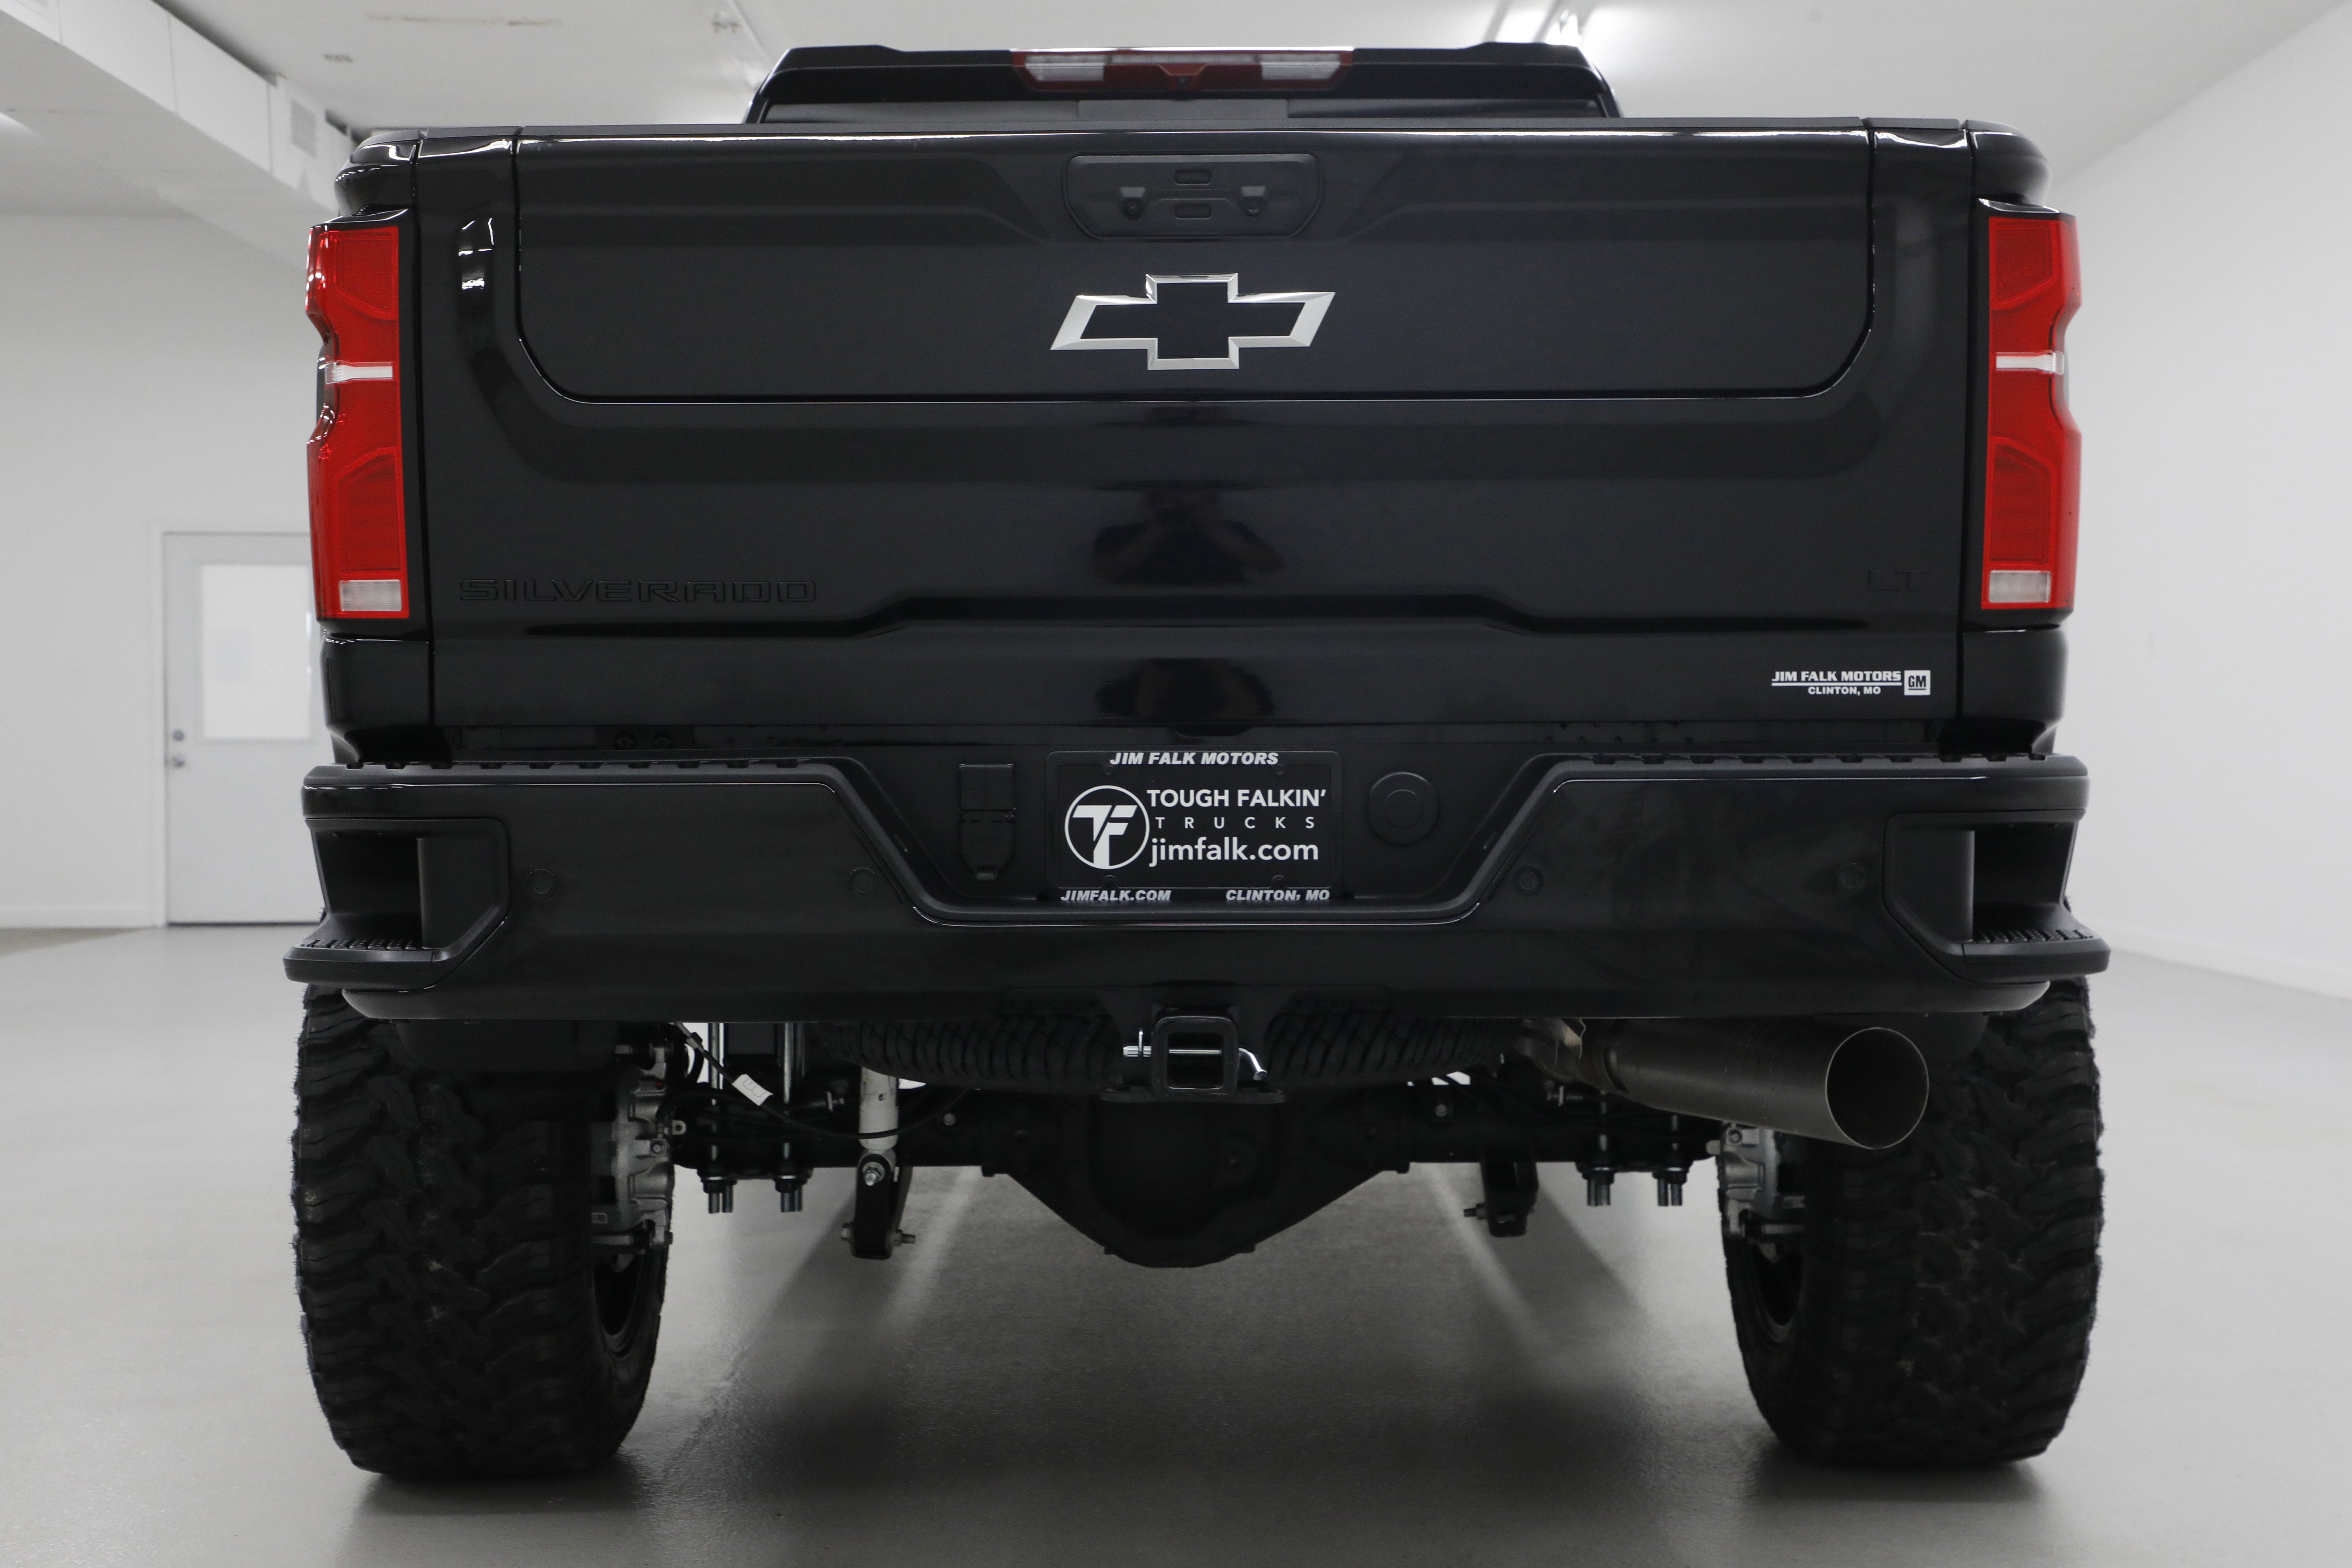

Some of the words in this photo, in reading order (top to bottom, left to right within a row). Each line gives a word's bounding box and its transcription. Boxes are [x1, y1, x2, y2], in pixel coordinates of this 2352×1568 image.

[1867, 568, 1931, 591] LT
[460, 578, 816, 603] SILVERADO
[1771, 670, 1797, 682] JIM
[1801, 670, 1838, 682] FALK
[1841, 670, 1902, 682] MOTORS
[1908, 675, 1927, 687] GM
[1808, 686, 1861, 696] CLINTON,
[1863, 686, 1881, 694] MO
[1109, 752, 1144, 765] JIM
[1148, 752, 1196, 765] FALK
[1200, 752, 1279, 765] MOTORS
[1146, 789, 1229, 807] TOUGH
[1237, 788, 1326, 807] FALKIN'
[1155, 816, 1315, 829] TRUCKS
[1149, 836, 1319, 867] jimfalk.com
[1061, 890, 1172, 901] JIMFALK.COM
[1226, 889, 1301, 901] CLINTON,
[1305, 889, 1330, 901] MO
